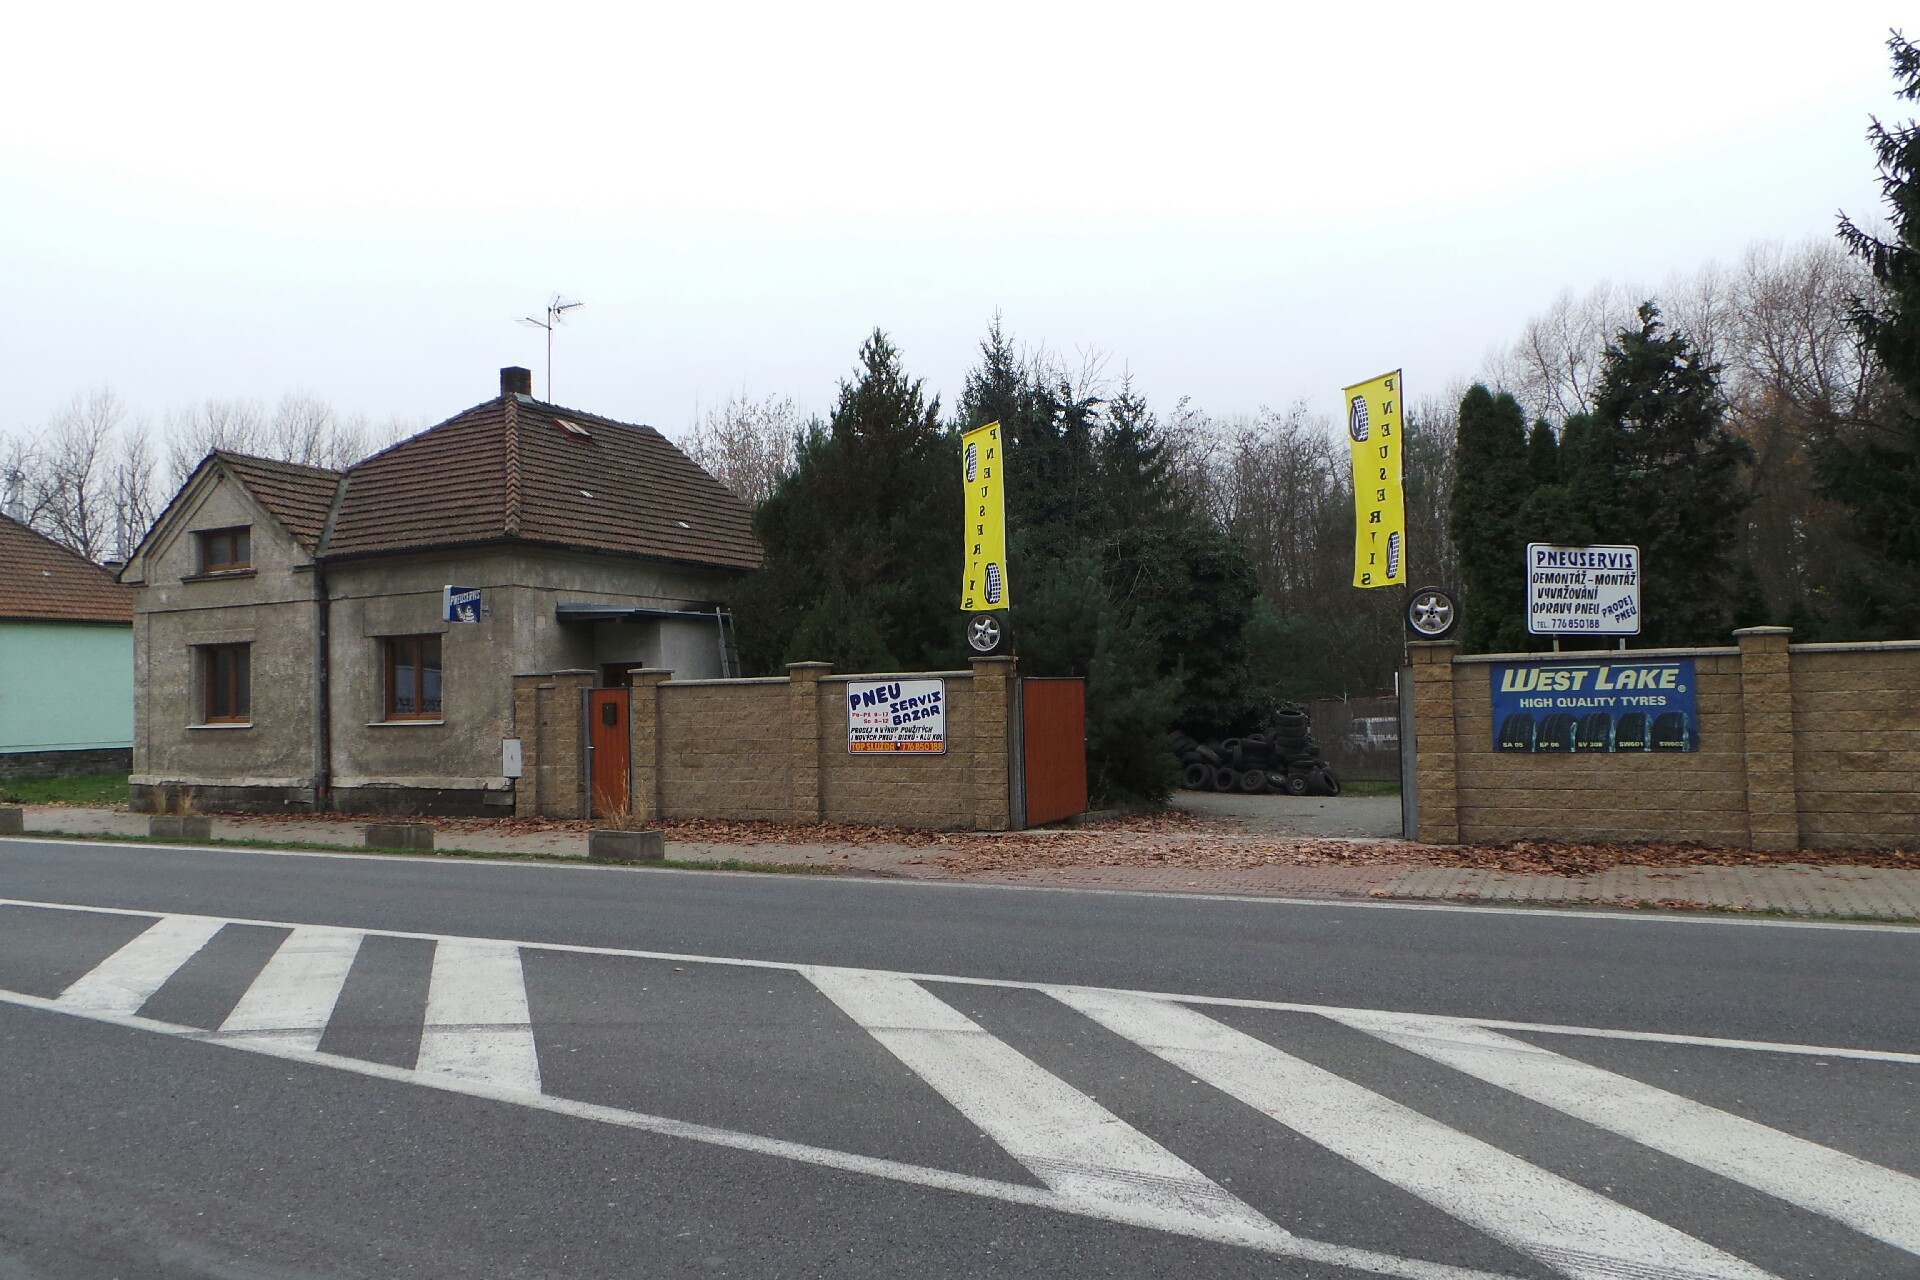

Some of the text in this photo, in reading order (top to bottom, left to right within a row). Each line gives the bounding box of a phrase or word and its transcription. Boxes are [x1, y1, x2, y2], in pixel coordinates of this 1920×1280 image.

[1536, 551, 1633, 569] PNEUSERVIS
[1537, 585, 1599, 600] VYVAŽOVÁNÍ
[1532, 602, 1600, 615] OPRAVY PNEU
[1601, 594, 1634, 618] PRODEJ
[1614, 606, 1637, 624] PNEU
[1501, 666, 1680, 692] WEST LAKE
[849, 682, 901, 711] PNEU
[1519, 695, 1667, 708] HIGH QUALITY TYRES
[892, 704, 940, 726] BAZAR
[851, 743, 866, 751] TOP
